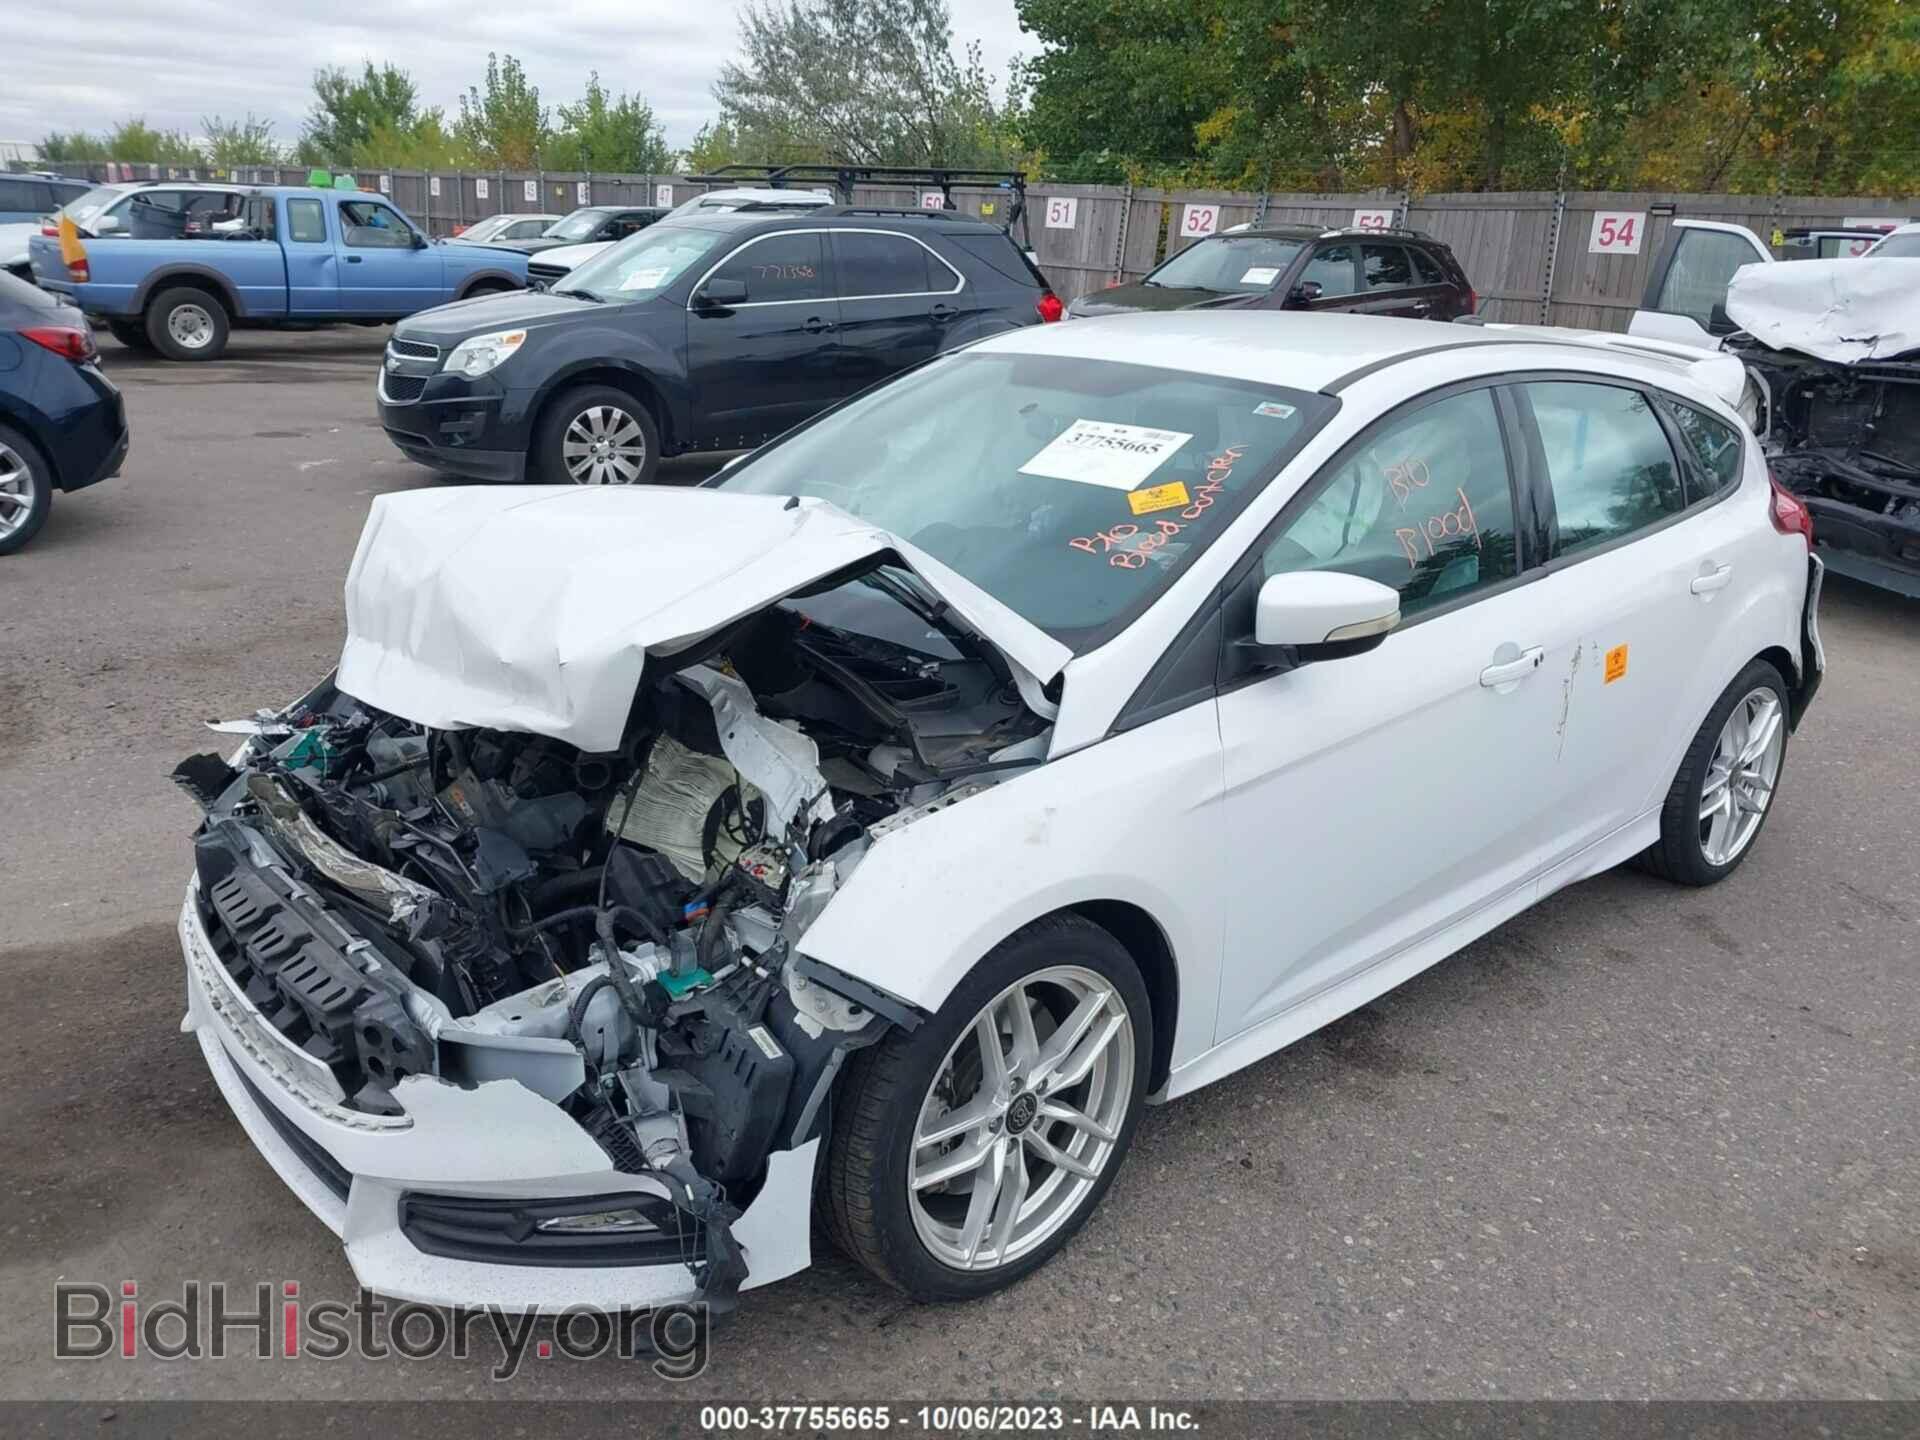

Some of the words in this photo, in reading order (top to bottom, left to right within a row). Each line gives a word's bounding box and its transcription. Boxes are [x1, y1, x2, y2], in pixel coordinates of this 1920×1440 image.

[1051, 202, 1070, 223] 51
[1187, 210, 1212, 232] 52
[1599, 218, 1634, 246] 54
